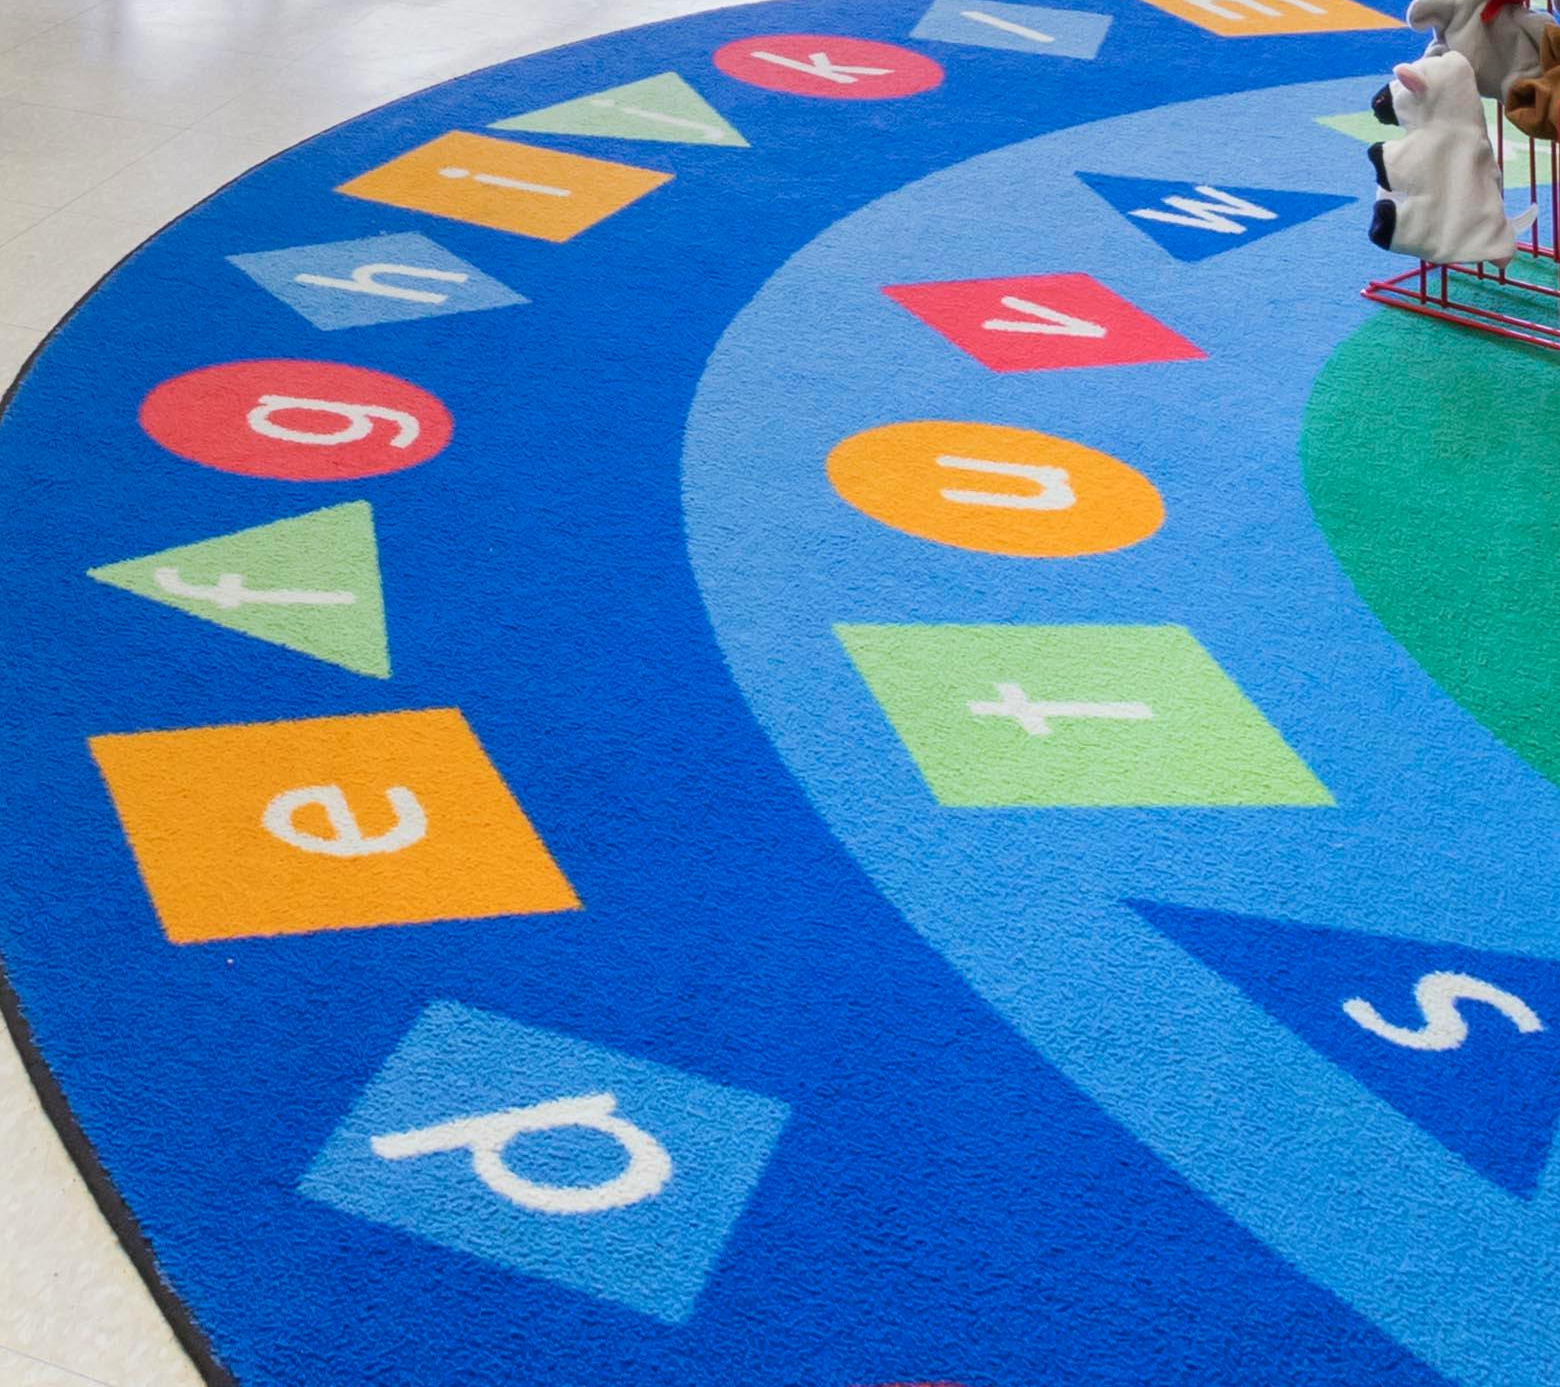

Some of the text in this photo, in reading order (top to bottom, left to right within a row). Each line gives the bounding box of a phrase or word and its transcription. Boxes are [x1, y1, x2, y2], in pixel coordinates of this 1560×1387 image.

[751, 51, 894, 83] k
[1132, 186, 1276, 233] w
[295, 263, 468, 304] h
[983, 297, 1106, 337] v
[247, 395, 420, 448] g
[938, 456, 1076, 510] u
[152, 566, 356, 609] f
[967, 681, 1153, 734] t
[264, 786, 427, 855] e
[1344, 972, 1541, 1050] s
